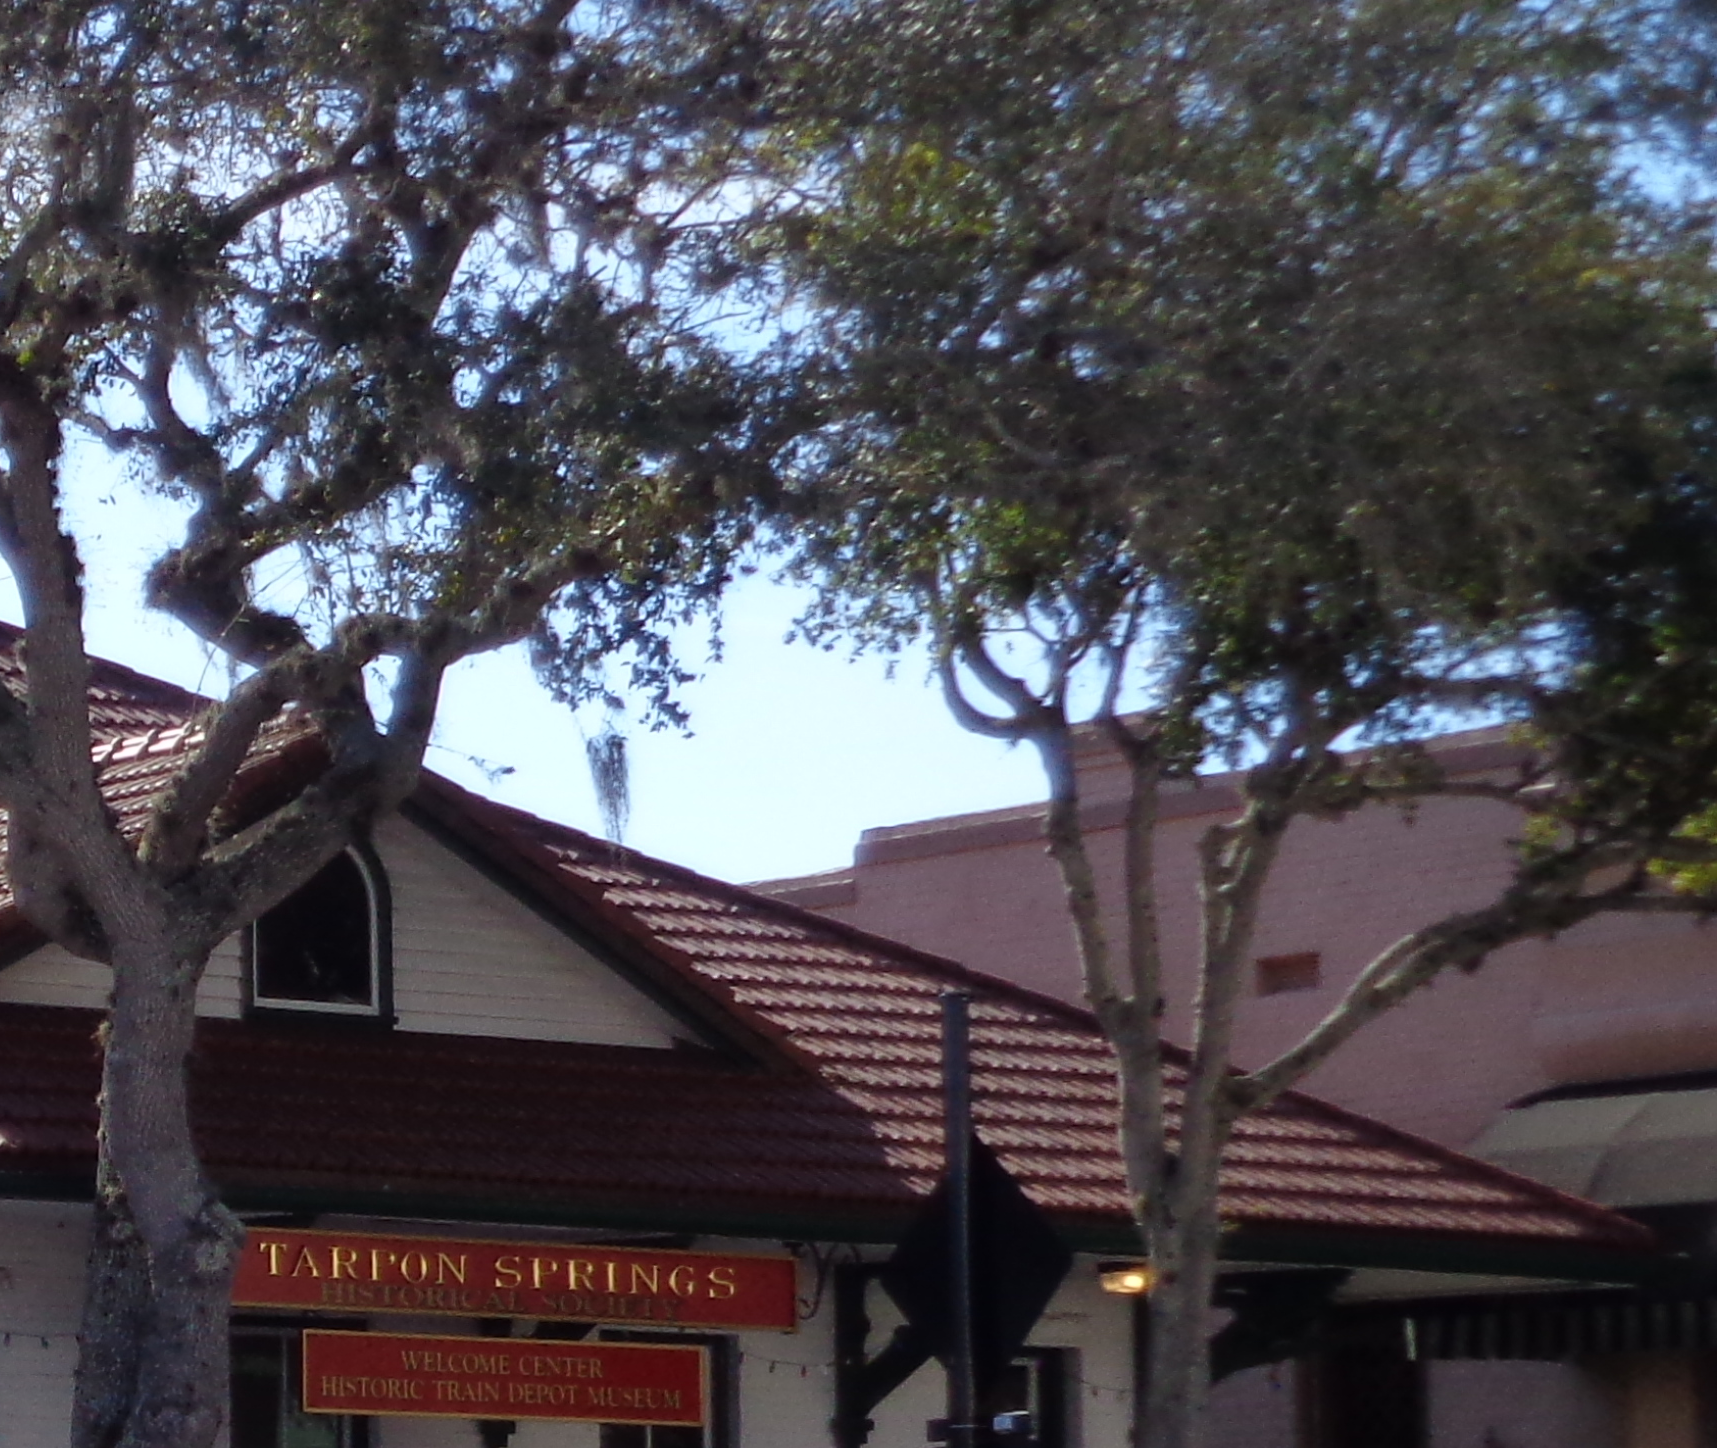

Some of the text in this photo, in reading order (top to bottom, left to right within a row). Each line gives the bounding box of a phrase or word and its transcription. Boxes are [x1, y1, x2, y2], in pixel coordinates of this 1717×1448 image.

[260, 1242, 737, 1300] TARPON SPRINGS
[321, 1282, 680, 1320] HISTORICAL SOCIETY
[401, 1350, 603, 1378] WELCOME CENTER
[321, 1376, 681, 1410] HISTORIC TRAIN DEPOT MUSEUM
